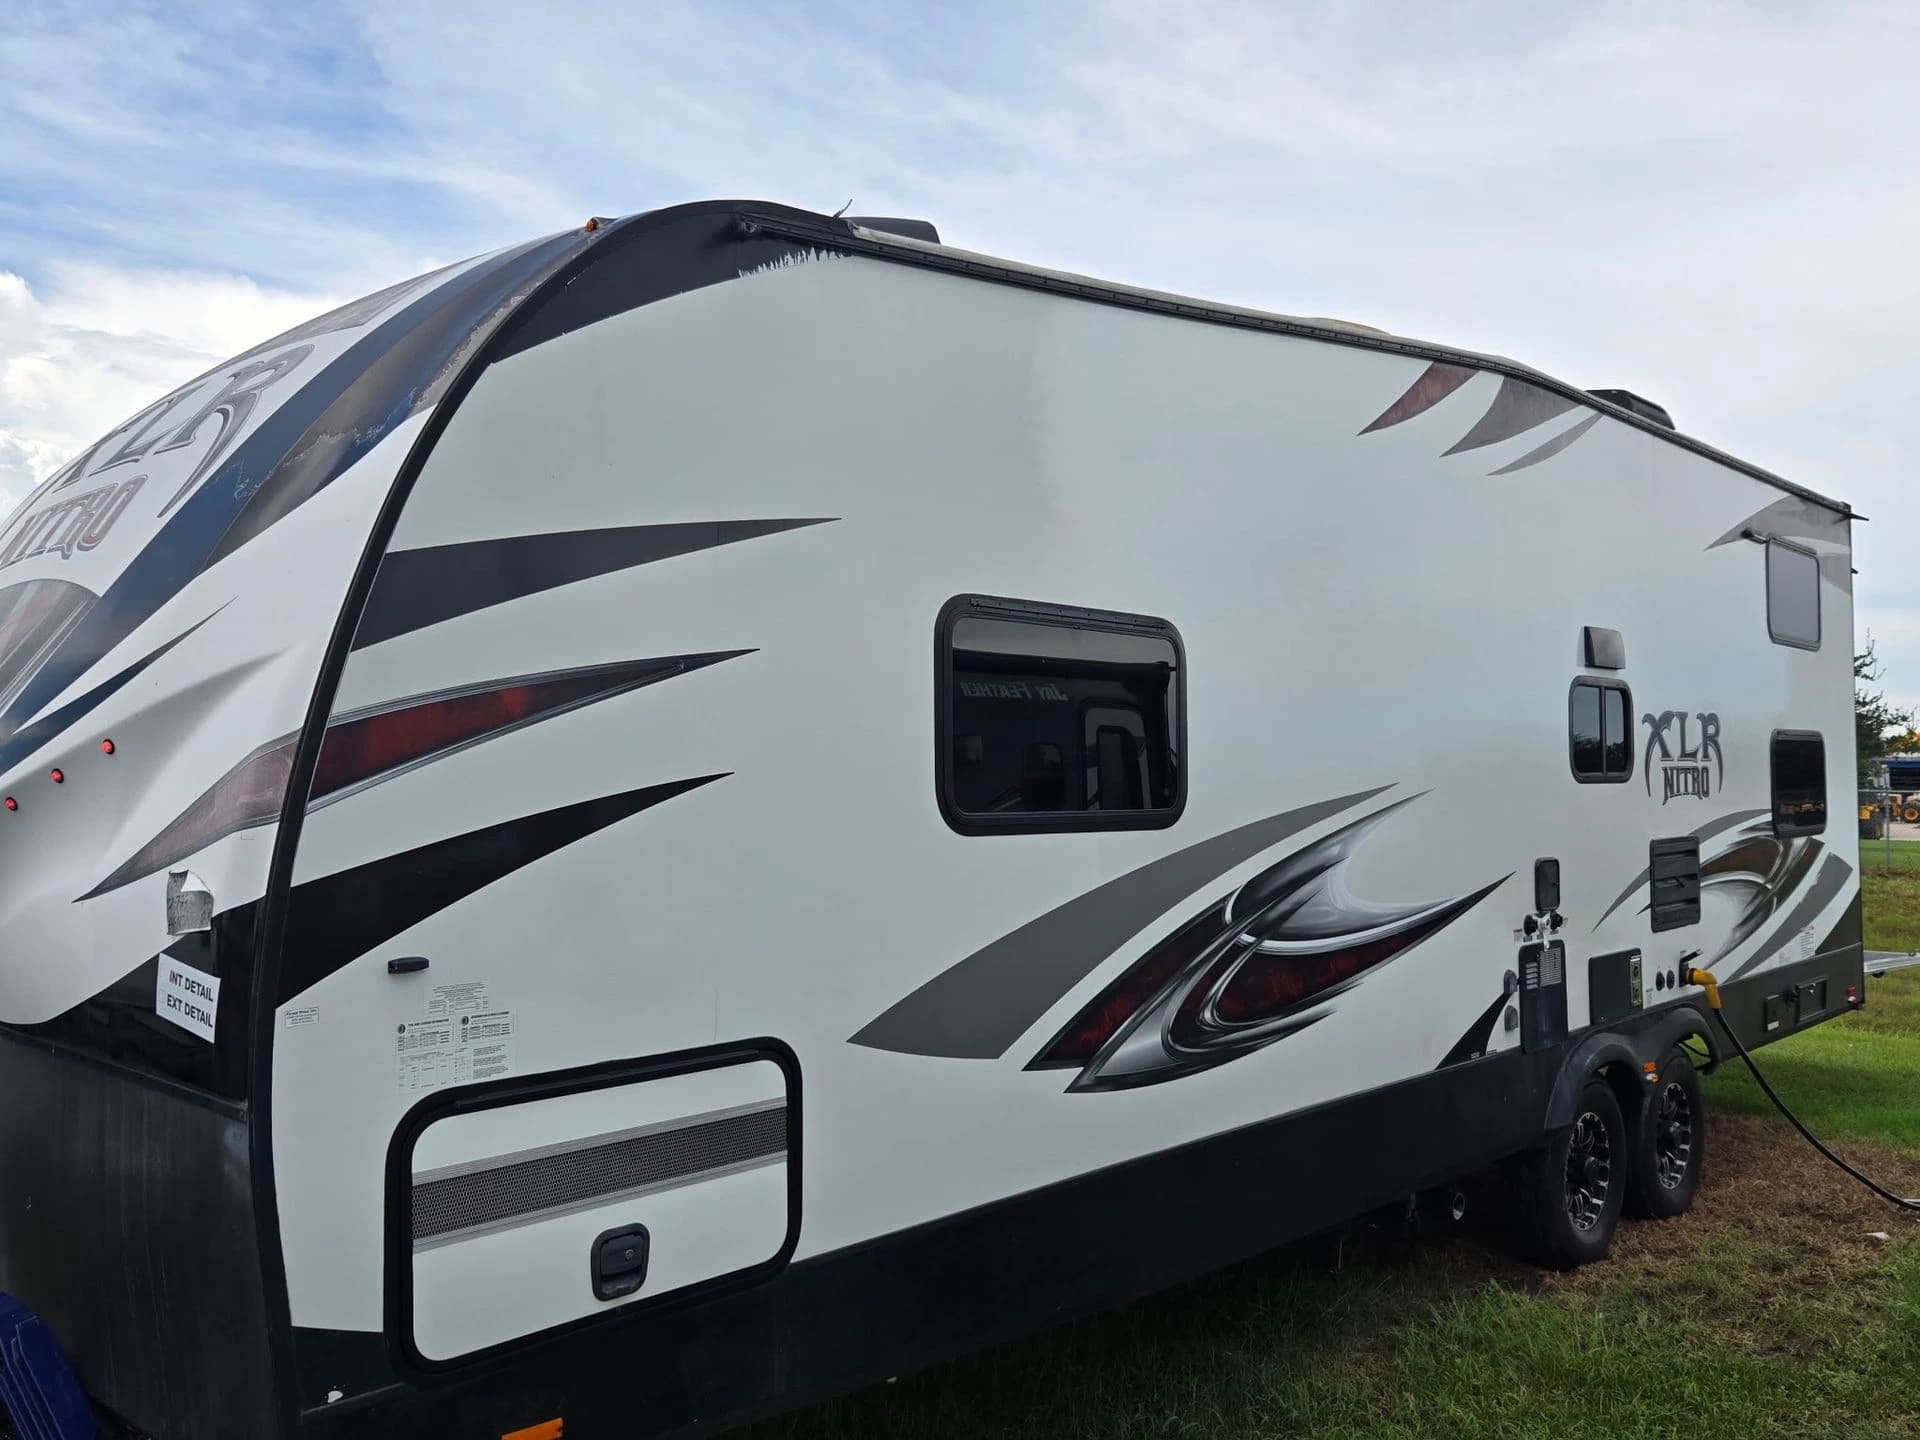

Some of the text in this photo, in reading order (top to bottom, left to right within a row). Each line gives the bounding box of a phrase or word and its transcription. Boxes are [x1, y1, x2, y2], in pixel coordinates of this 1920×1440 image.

[1641, 710, 1723, 798] XLR
[1661, 765, 1709, 806] NITRO
[169, 969, 214, 1002] INT DETAIL
[167, 994, 213, 1028] EXT DETAIL
